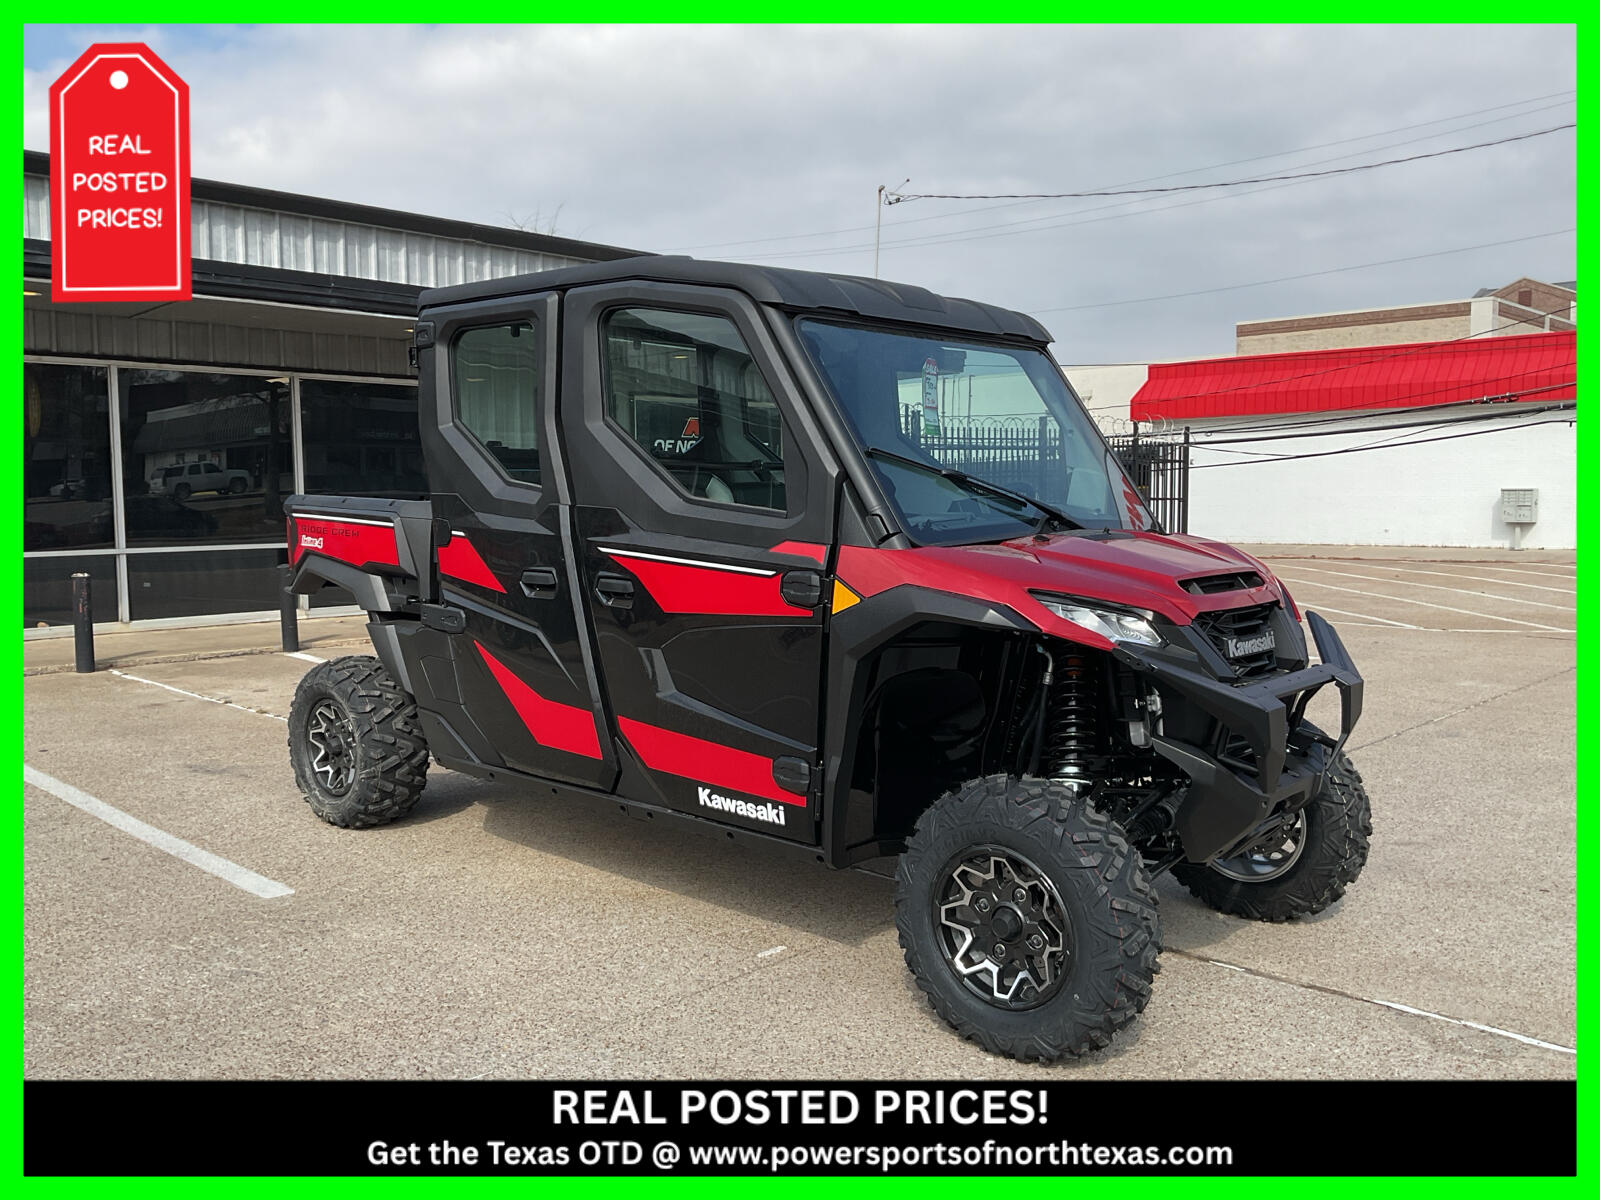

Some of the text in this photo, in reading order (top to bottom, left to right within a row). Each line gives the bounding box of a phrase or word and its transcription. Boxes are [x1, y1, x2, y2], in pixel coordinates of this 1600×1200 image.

[301, 525, 359, 537] RIDGE CREW
[1228, 631, 1275, 657] Kawasaki
[698, 787, 785, 826] Kawasaki
